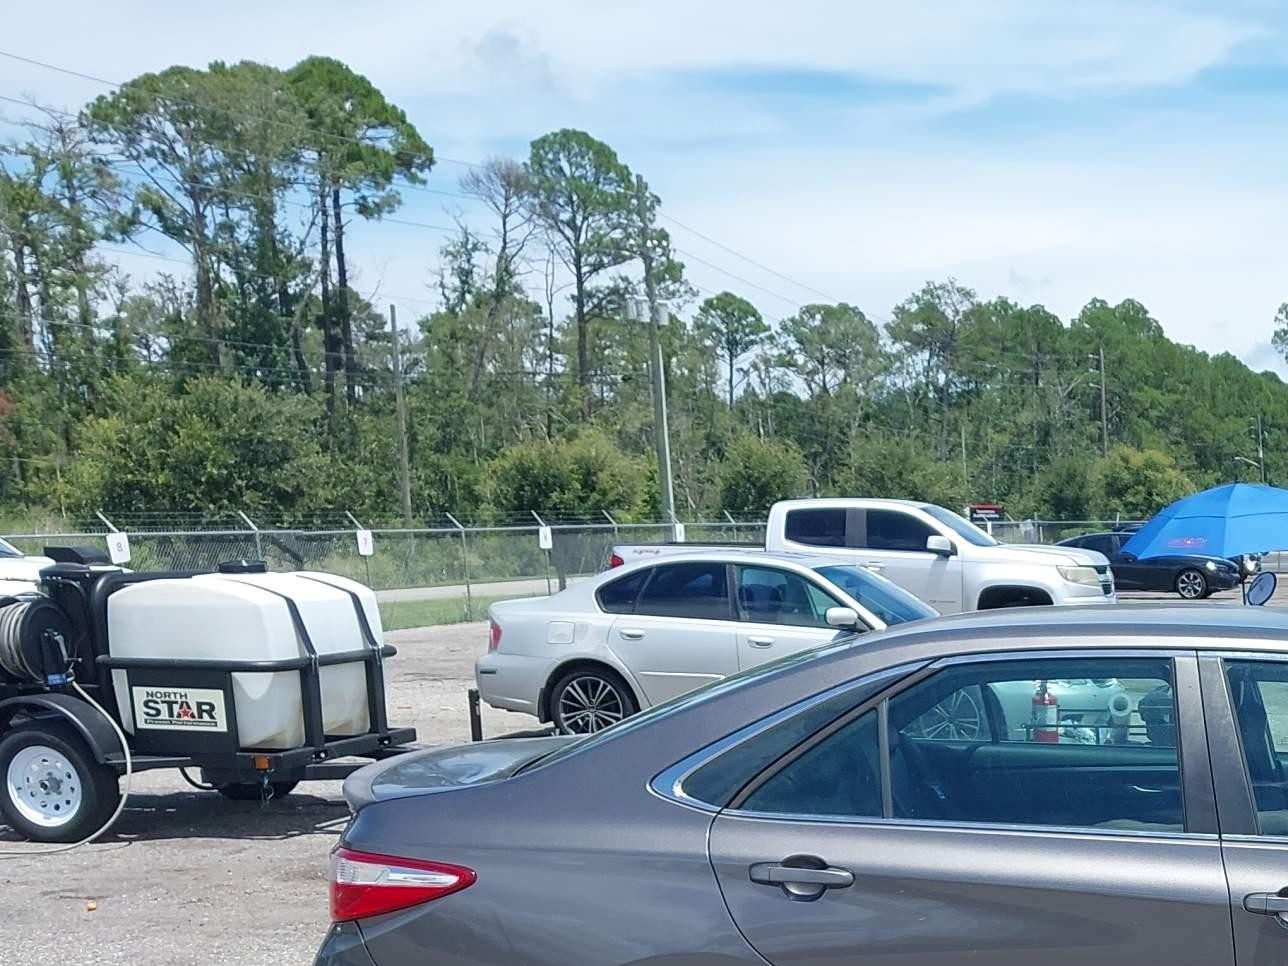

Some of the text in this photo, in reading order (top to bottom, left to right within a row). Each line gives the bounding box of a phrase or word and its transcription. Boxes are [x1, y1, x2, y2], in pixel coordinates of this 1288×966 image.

[116, 542, 123, 552] 8
[145, 690, 188, 700] NORTH
[142, 699, 217, 720] STAR
